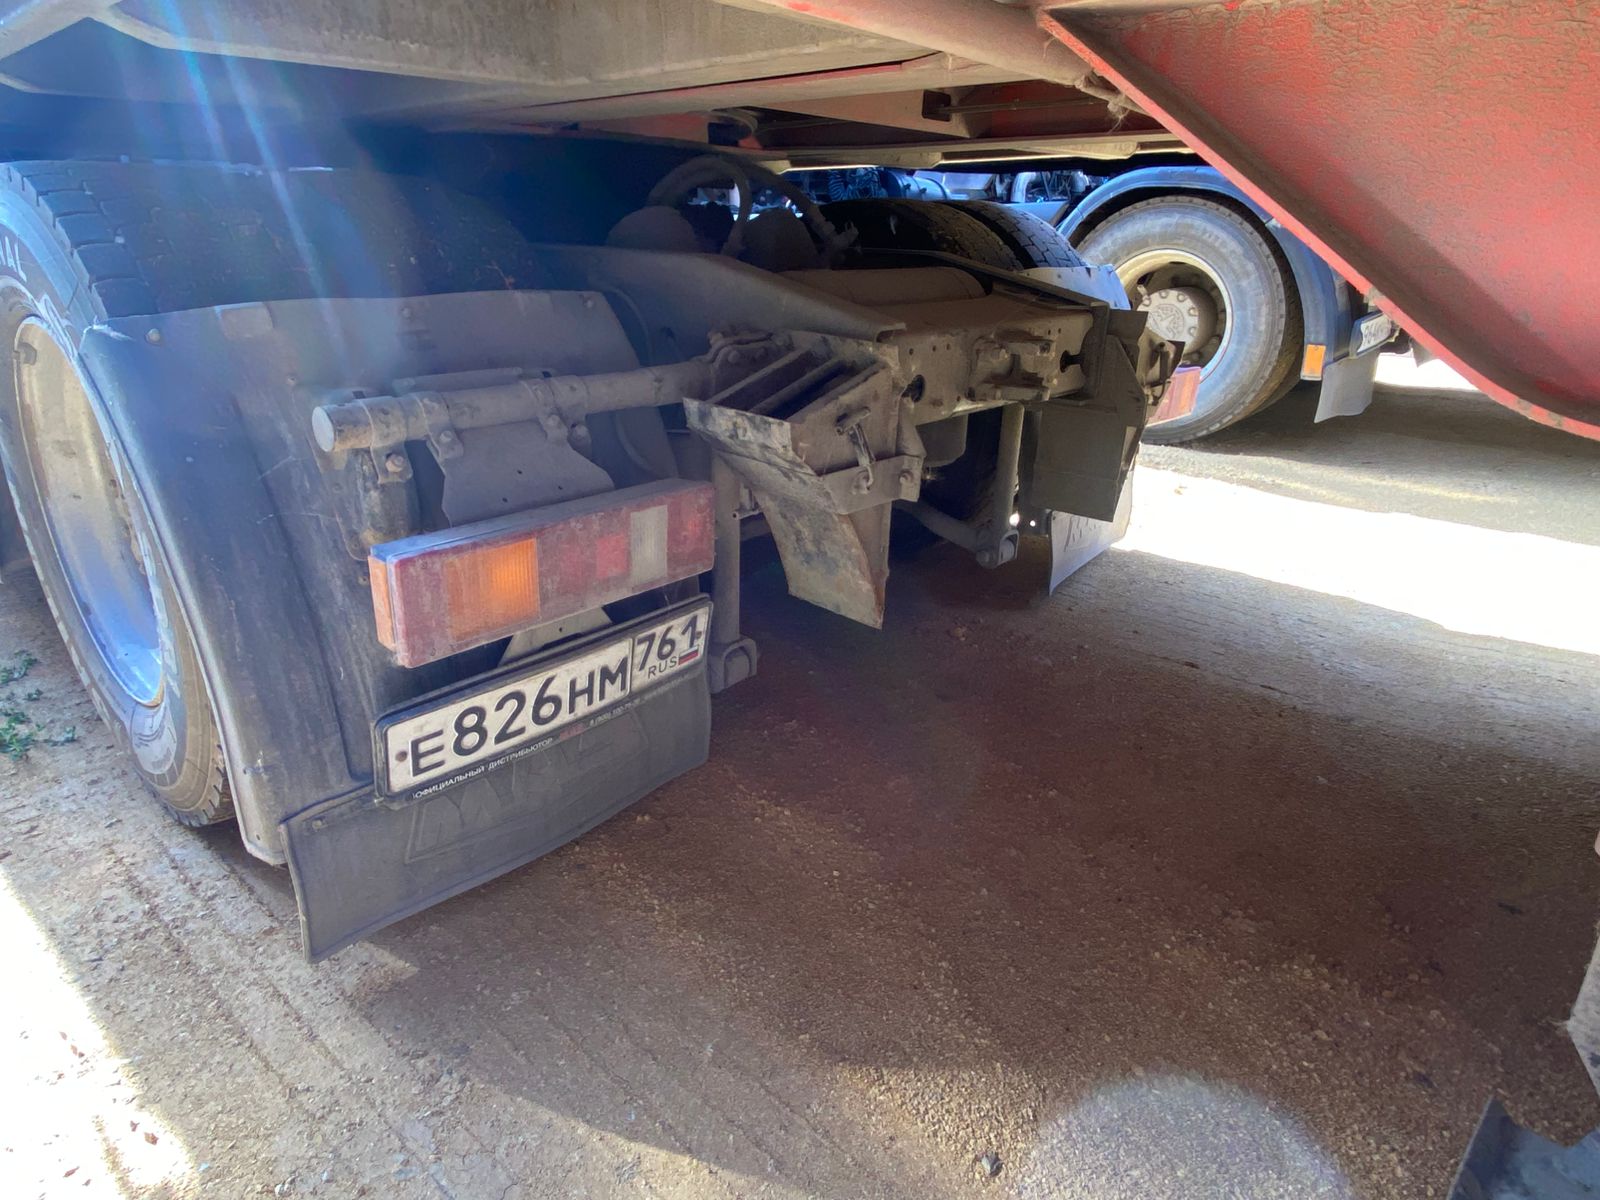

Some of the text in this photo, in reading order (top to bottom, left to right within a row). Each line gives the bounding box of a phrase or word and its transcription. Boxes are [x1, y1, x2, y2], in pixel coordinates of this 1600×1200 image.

[637, 615, 699, 671] 761
[648, 656, 678, 679] RUS
[414, 737, 553, 799] ОФИЦИАЛЬНЫЙ ДИСТРИБЬЮТОР
